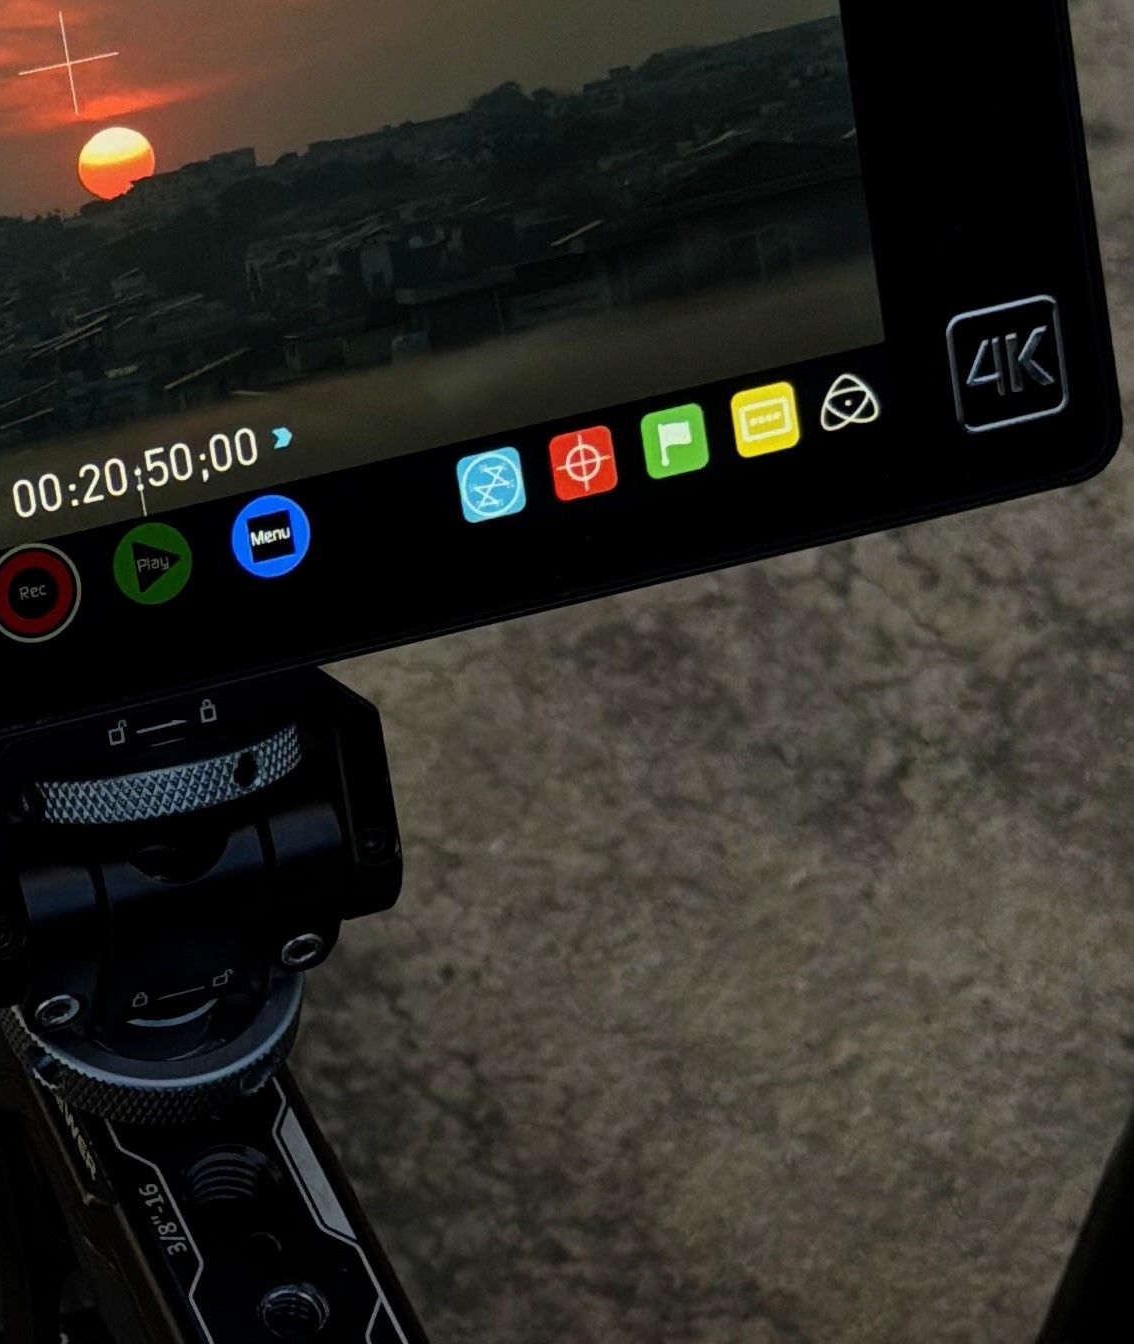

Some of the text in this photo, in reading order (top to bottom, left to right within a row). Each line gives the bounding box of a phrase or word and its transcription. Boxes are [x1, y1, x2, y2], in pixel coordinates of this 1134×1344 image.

[966, 325, 1054, 397] 4K
[250, 527, 292, 547] Menu
[137, 556, 170, 573] Play
[19, 584, 47, 601] Rec
[138, 1182, 188, 1256] 3/8"-16
